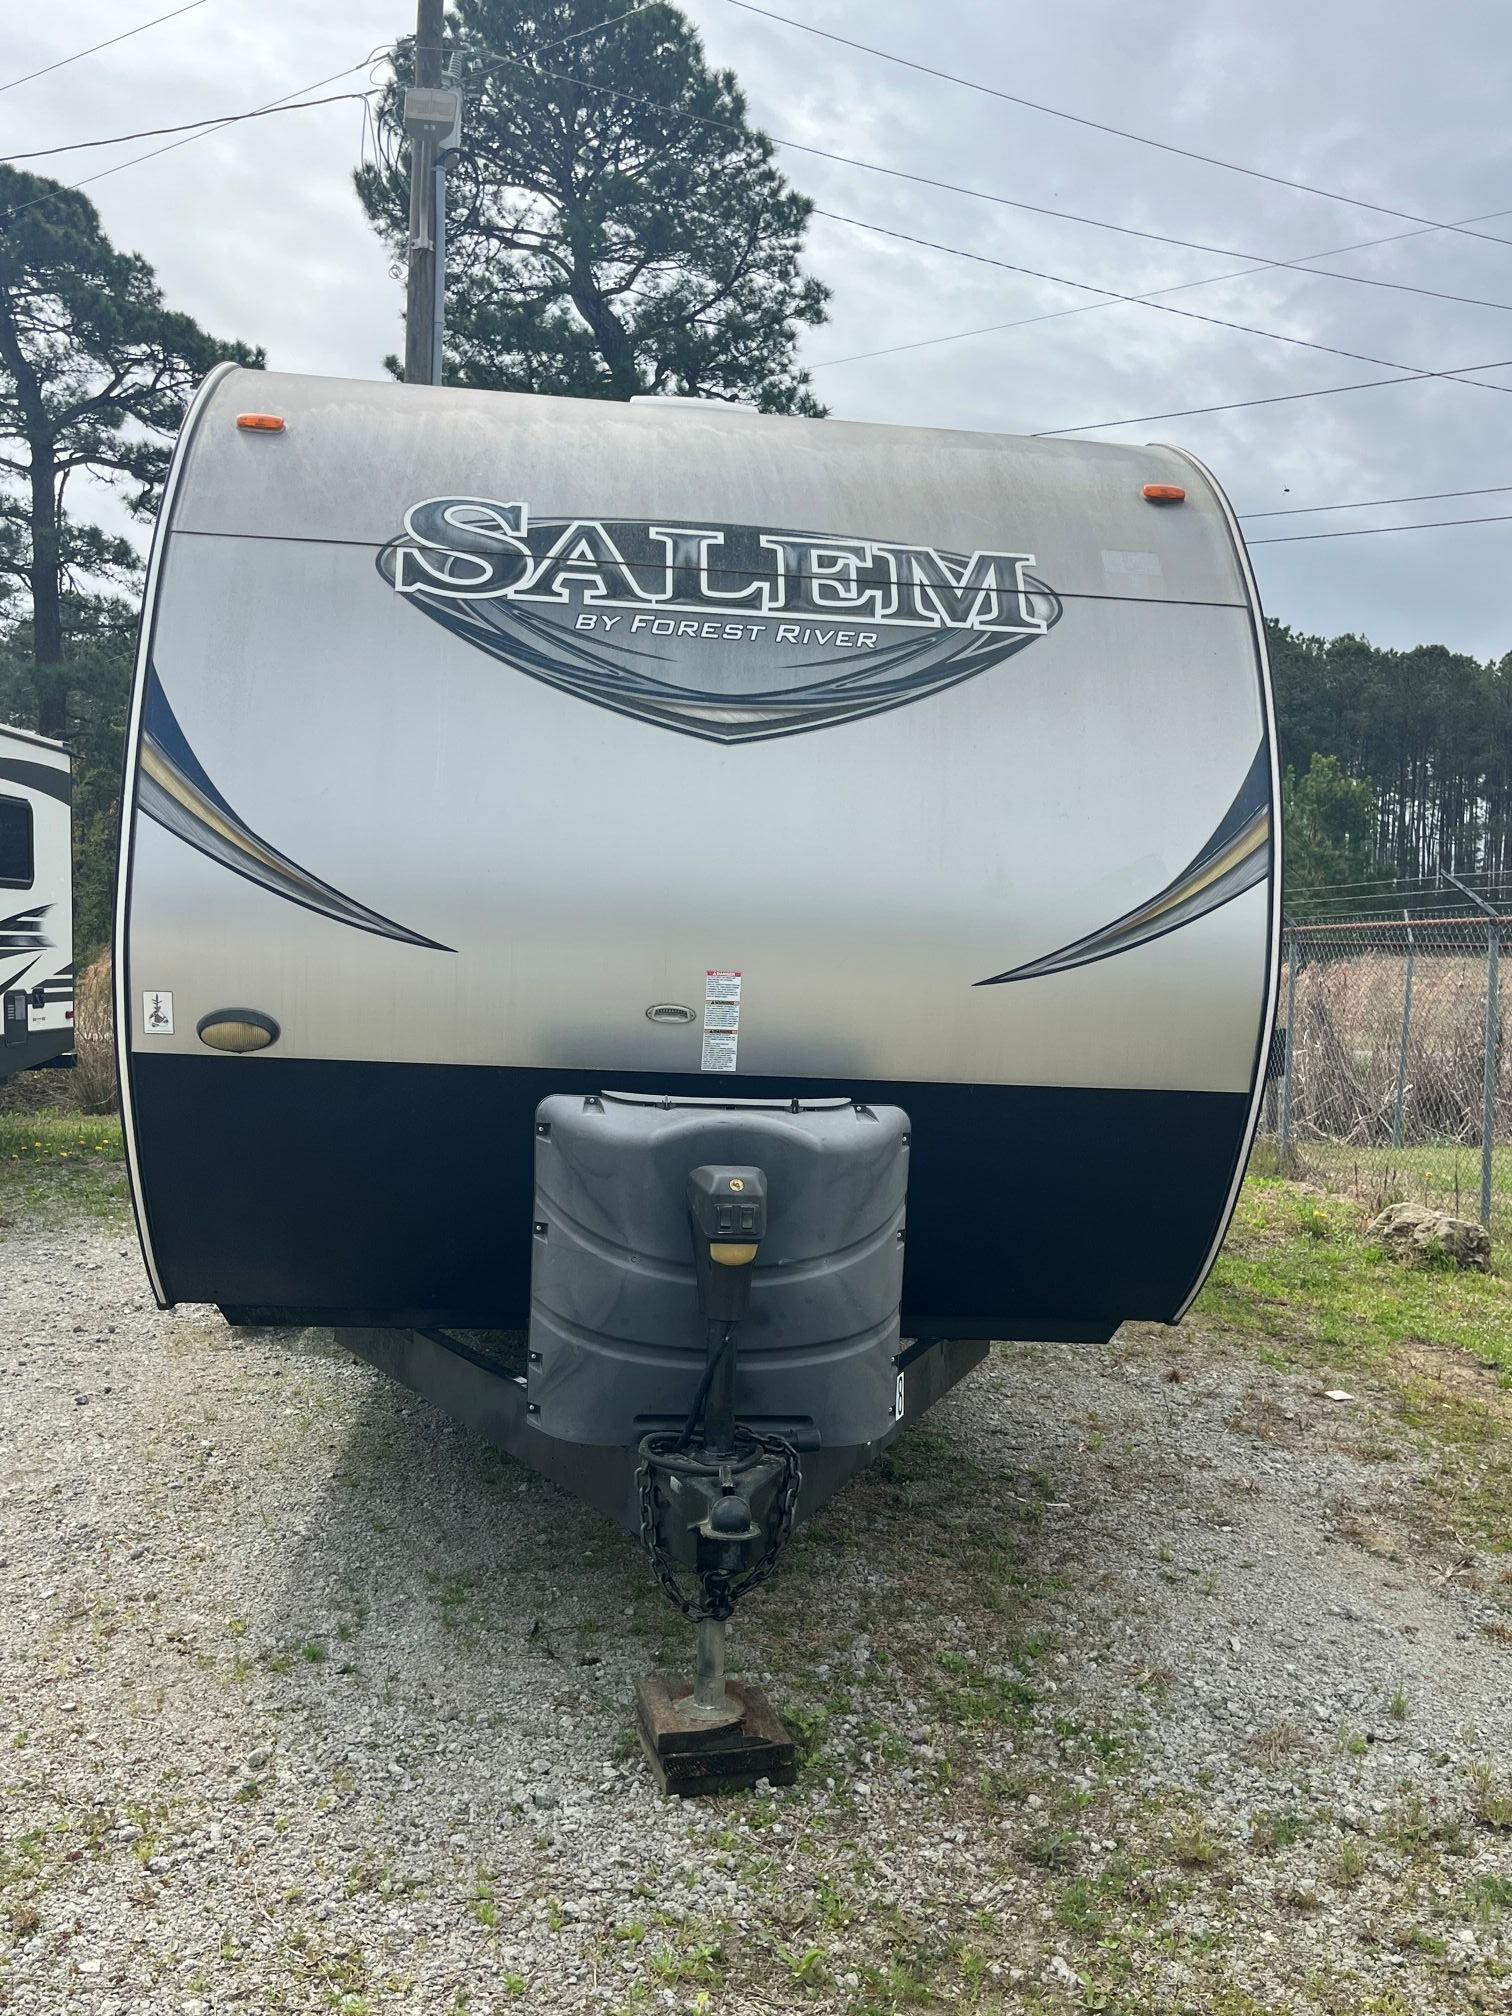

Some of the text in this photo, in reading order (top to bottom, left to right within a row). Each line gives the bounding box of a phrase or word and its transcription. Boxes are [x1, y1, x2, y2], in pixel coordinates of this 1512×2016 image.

[395, 495, 1047, 634] SALEM
[575, 614, 878, 649] BY FOREST RIVER
